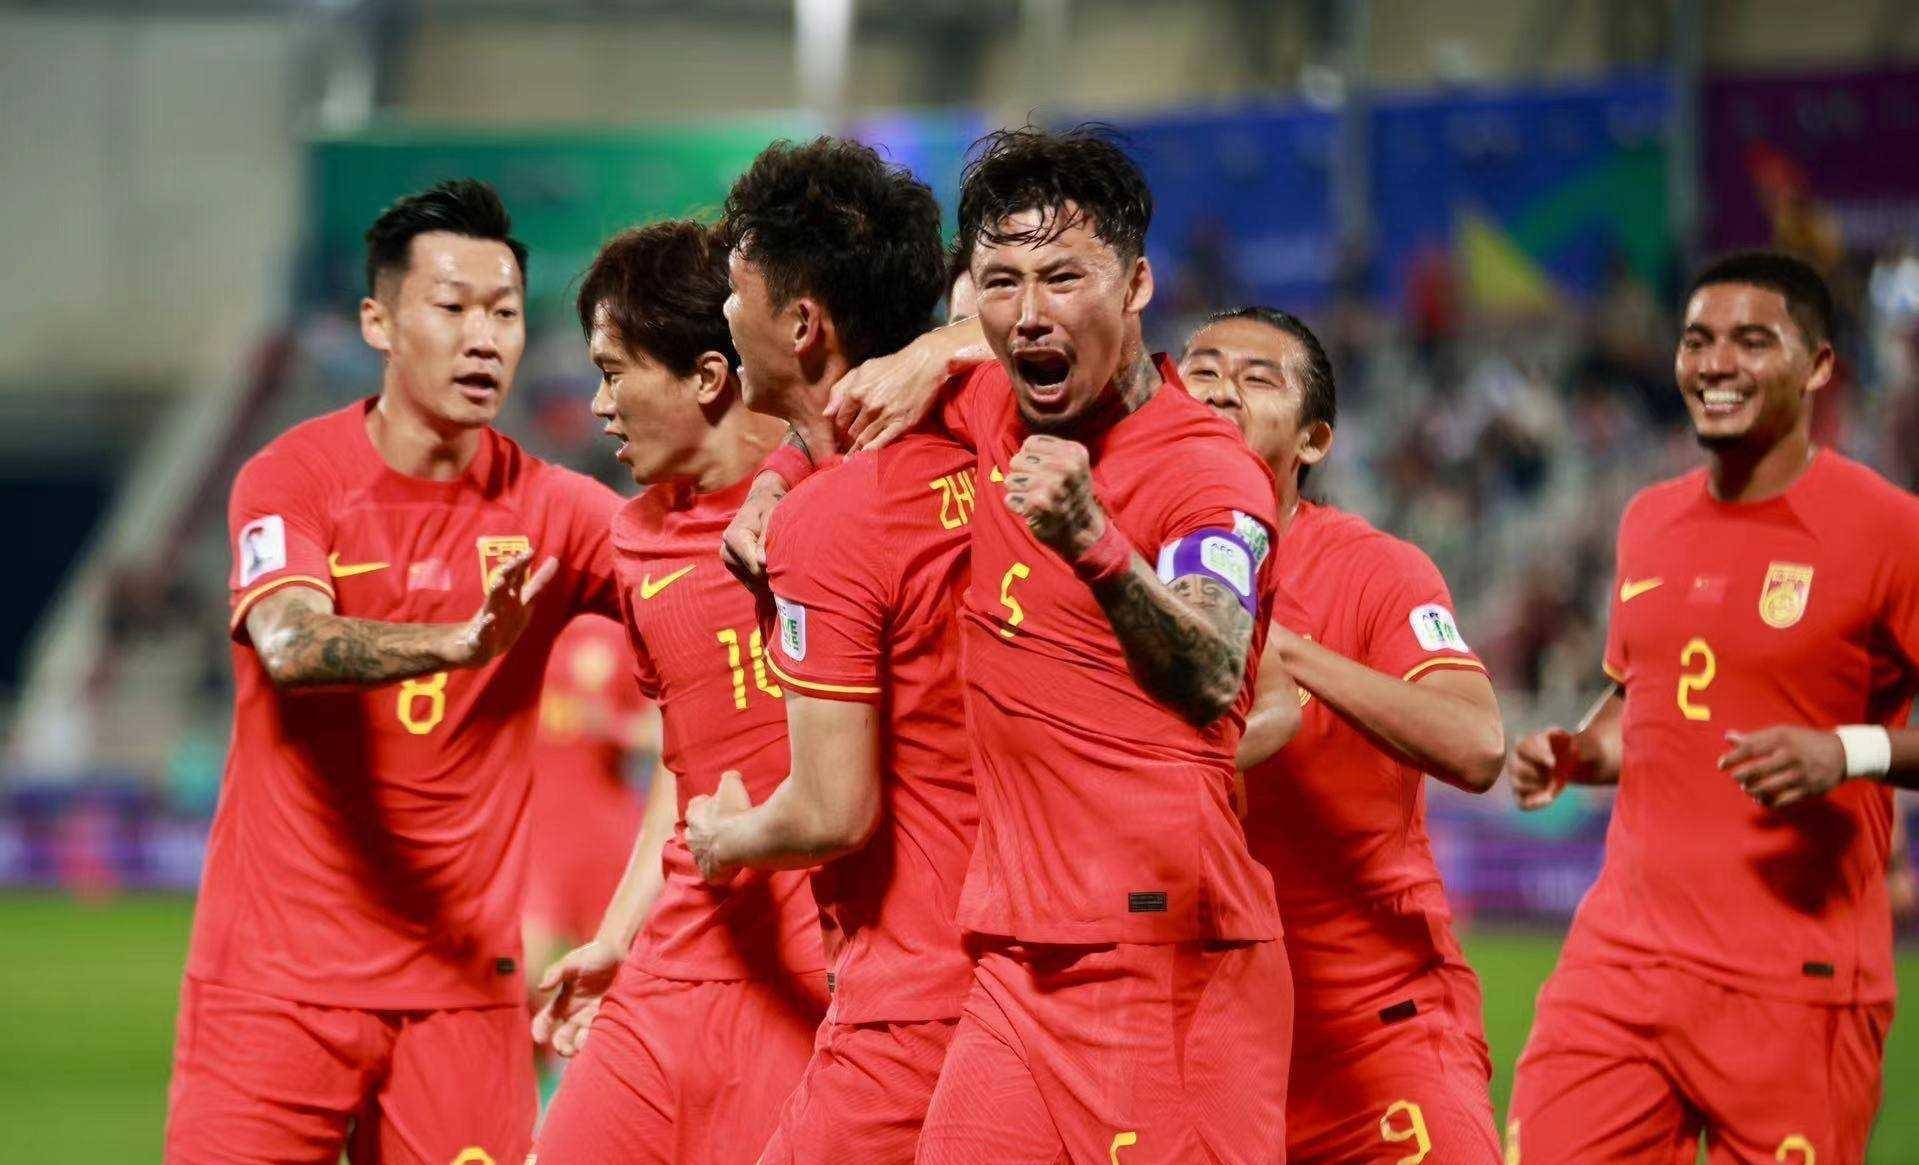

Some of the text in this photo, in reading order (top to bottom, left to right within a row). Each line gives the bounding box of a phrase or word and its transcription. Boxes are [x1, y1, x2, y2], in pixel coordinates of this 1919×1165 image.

[929, 469, 977, 530] ZH
[1000, 561, 1031, 638] 5
[397, 671, 448, 735] 8
[1677, 637, 1716, 721] 2
[1379, 1099, 1432, 1165] 9
